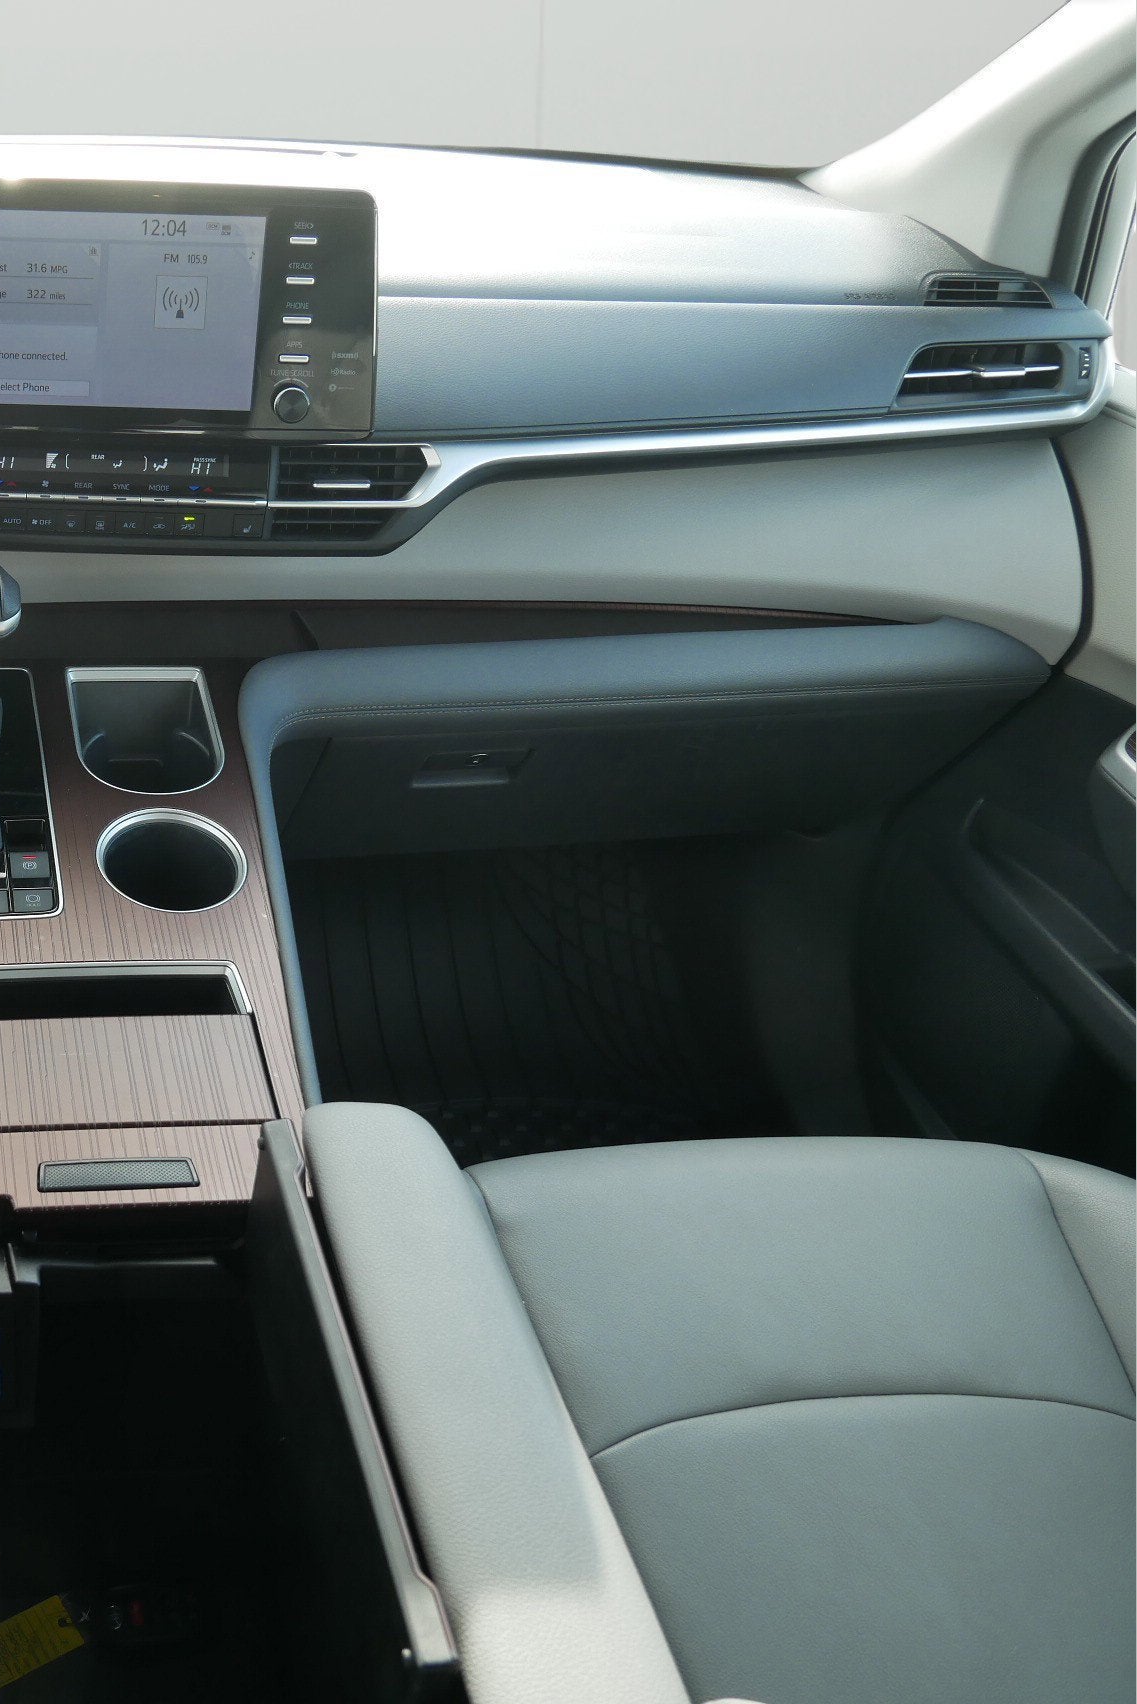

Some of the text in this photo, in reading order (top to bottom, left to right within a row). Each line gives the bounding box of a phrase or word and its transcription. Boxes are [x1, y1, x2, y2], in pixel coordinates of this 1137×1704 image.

[141, 218, 187, 237] 12:04
[164, 253, 179, 263] FM
[187, 254, 208, 265] 105.9
[26, 262, 47, 273] 31.6
[50, 265, 68, 274] MPG
[26, 289, 46, 299] 322
[49, 291, 66, 300] miles
[285, 301, 309, 310] PHONE
[286, 340, 303, 349] APPS
[22, 351, 68, 361] connected.
[22, 382, 50, 392] Phone
